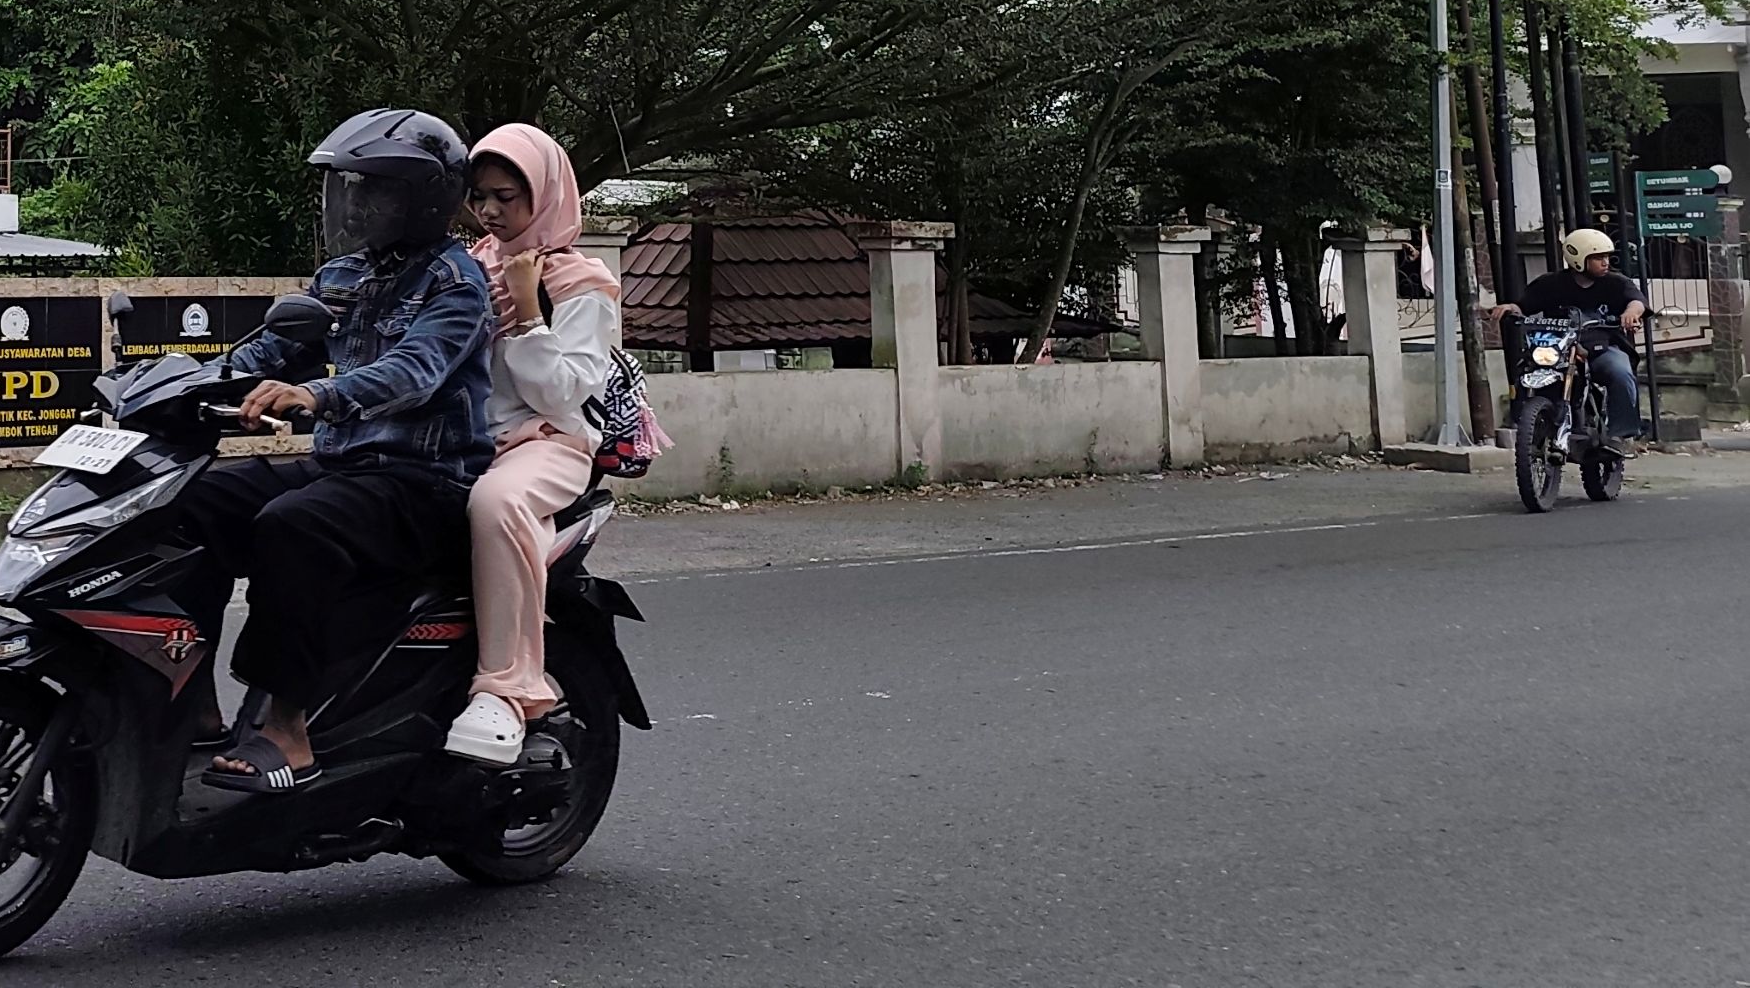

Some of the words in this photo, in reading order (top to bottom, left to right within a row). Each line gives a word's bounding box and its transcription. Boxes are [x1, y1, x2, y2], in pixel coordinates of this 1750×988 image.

[67, 347, 92, 358] DESA
[122, 344, 159, 355] LEMBAGA
[161, 343, 221, 354] PEMBERDAYAAN
[16, 409, 37, 421] KEC.
[38, 408, 76, 420] JONGGAT
[24, 424, 58, 437] TENGAH
[67, 570, 123, 598] HONDA
